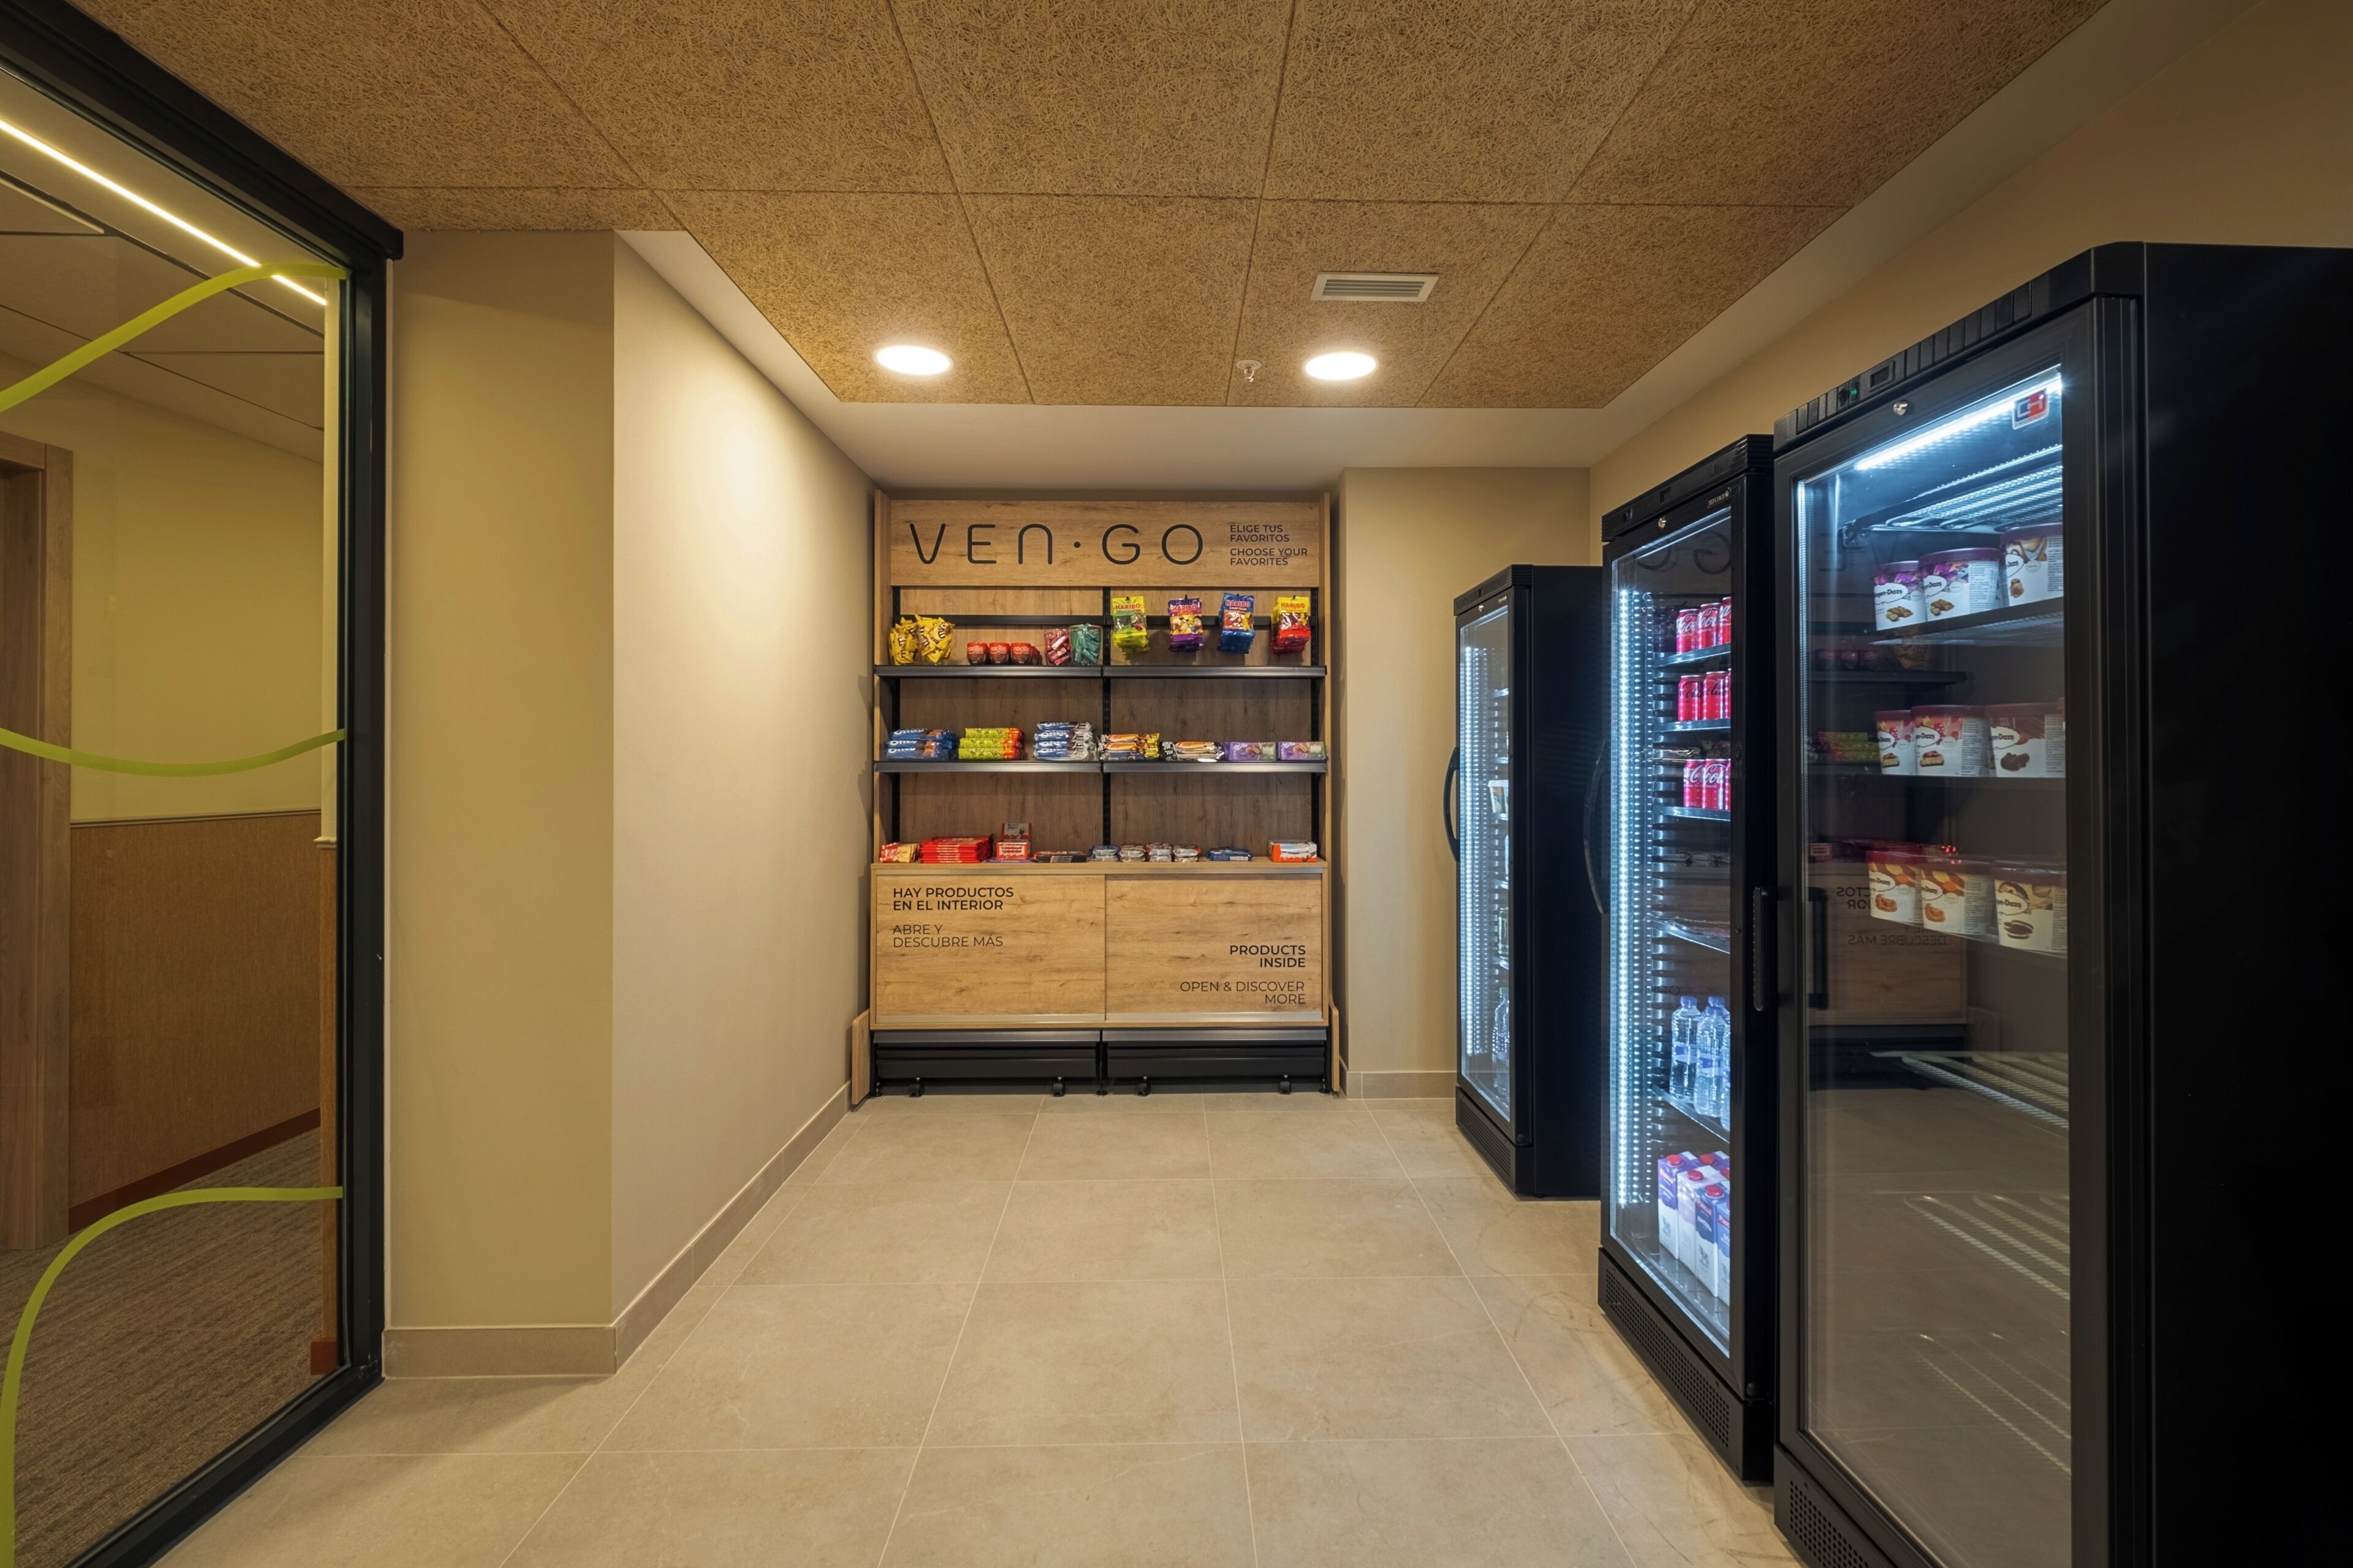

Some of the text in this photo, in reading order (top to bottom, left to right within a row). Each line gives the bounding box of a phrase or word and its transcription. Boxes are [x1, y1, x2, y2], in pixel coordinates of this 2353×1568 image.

[1172, 604, 1197, 612] HARIBO
[893, 887, 1014, 898] HAY PRODUCTOS
[893, 900, 1003, 911] EN EL INTERIOR
[893, 924, 943, 934] ABRE Y
[893, 933, 1003, 947] DESCUBRE MÁS
[1230, 945, 1306, 955] PRODUCTS
[1260, 958, 1306, 968] INSIDE
[1180, 982, 1305, 991] OPEN & DISCOVER
[1265, 994, 1305, 1004] MORE
